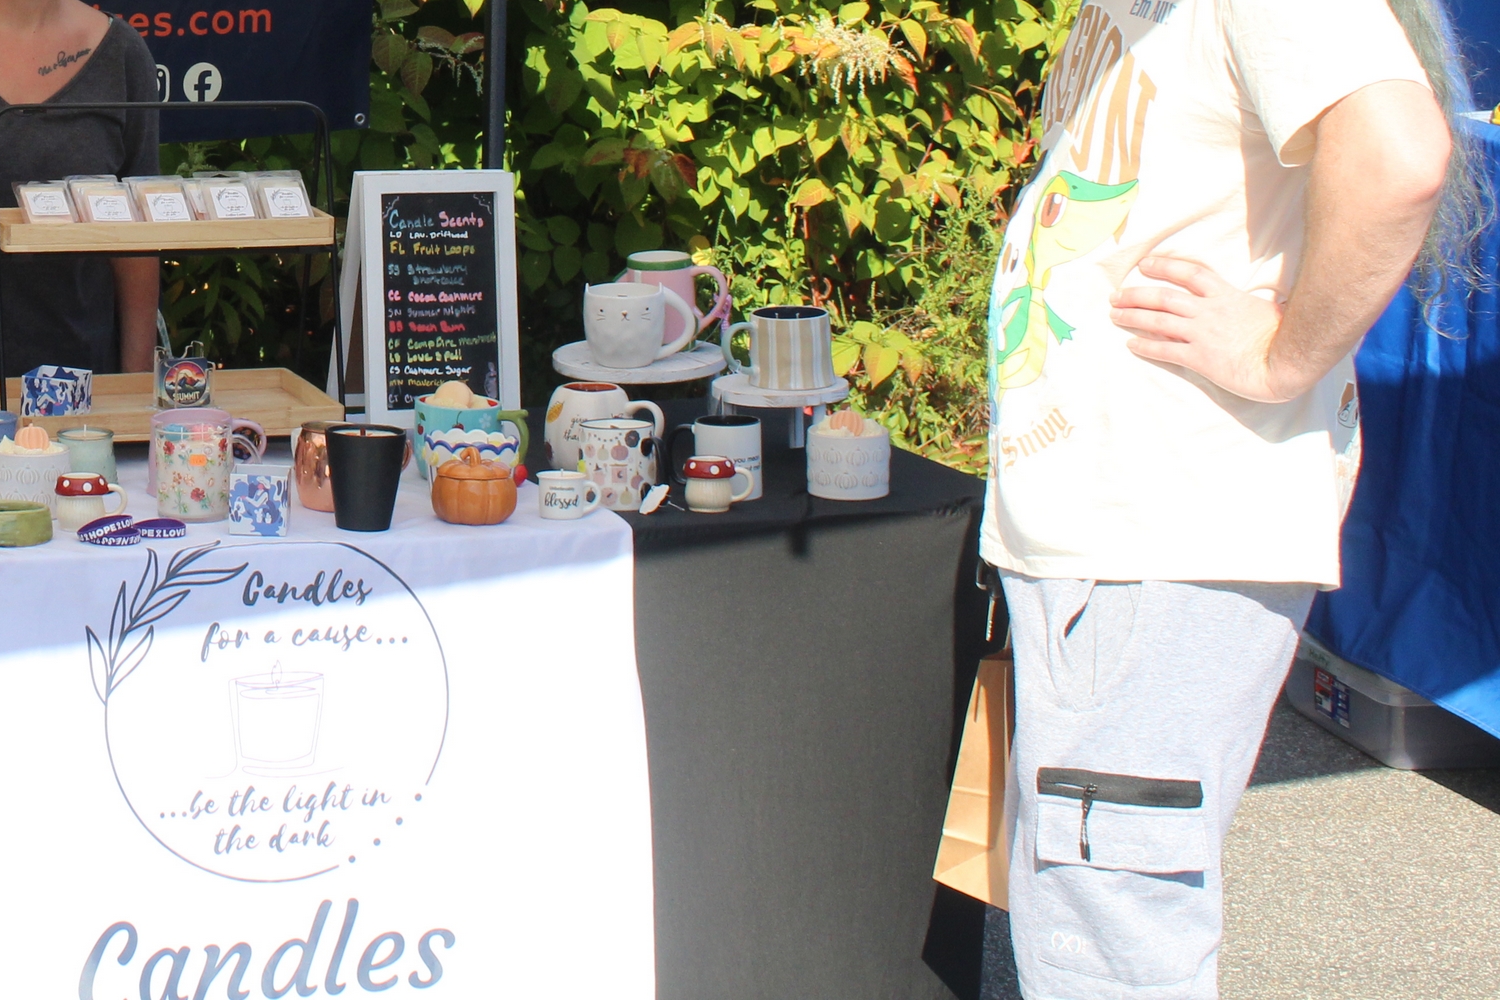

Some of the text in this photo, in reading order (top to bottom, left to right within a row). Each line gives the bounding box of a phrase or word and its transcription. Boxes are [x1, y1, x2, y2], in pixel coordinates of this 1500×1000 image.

[389, 209, 484, 230] Candle Scents
[389, 240, 406, 255] FL
[413, 242, 440, 256] Fruit
[387, 289, 402, 302] CC
[445, 365, 472, 377] Sugar
[1001, 408, 1077, 475] Snivy
[544, 492, 580, 510] blessed
[88, 524, 117, 540] HOPE
[162, 528, 185, 538] LOVE
[242, 567, 373, 608] Candles
[201, 620, 250, 664] for
[264, 625, 280, 645] a
[228, 786, 272, 816] the
[282, 782, 350, 814] light
[359, 784, 392, 808] in
[214, 819, 336, 857] the dark
[78, 897, 458, 1000] Candles
